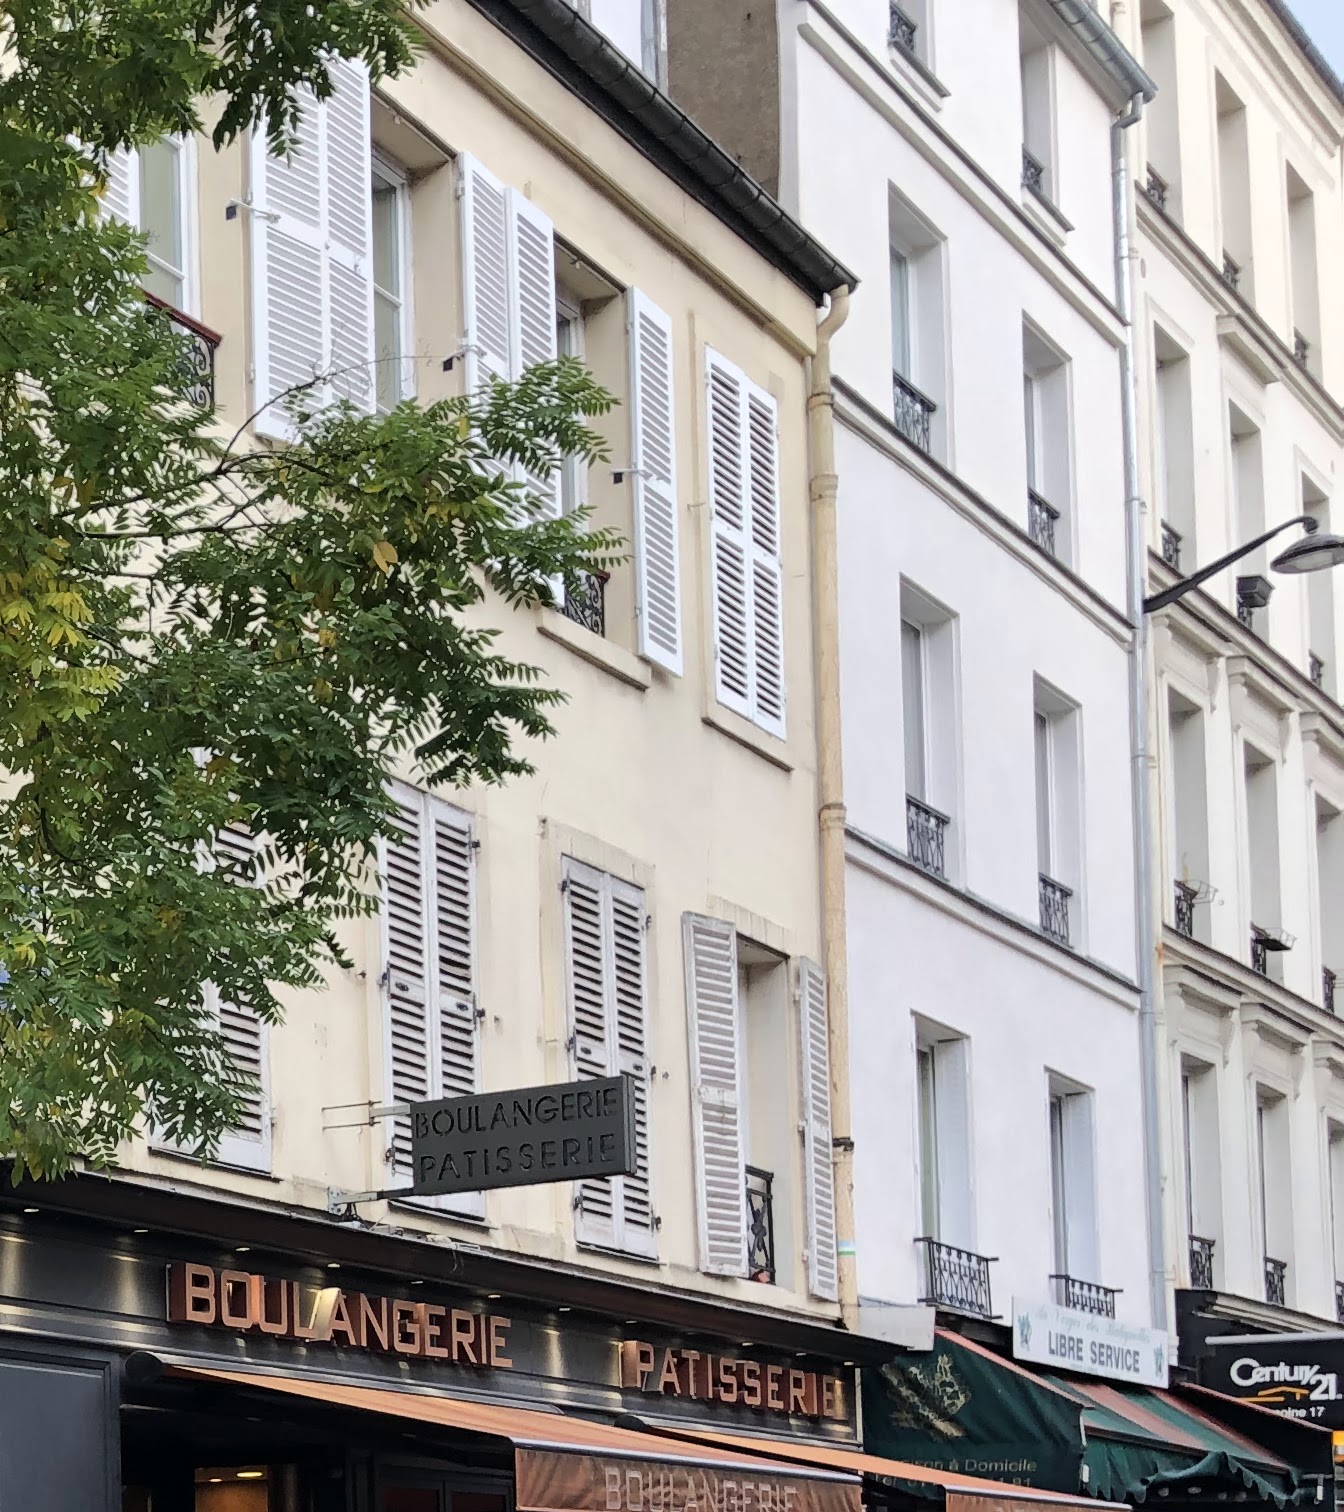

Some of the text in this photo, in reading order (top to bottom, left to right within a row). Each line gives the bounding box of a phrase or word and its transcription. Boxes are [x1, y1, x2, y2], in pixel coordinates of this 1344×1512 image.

[415, 1088, 618, 1139] BOULANGERIE
[420, 1133, 615, 1183] PATISSERIE
[184, 1262, 842, 1418] BOULANGERIE PATISSERIE
[1048, 1330, 1141, 1373] LIBRE SERVICE
[1230, 1358, 1320, 1387] Century
[1309, 1406, 1326, 1417] 17
[965, 1458, 1037, 1472] Domicile
